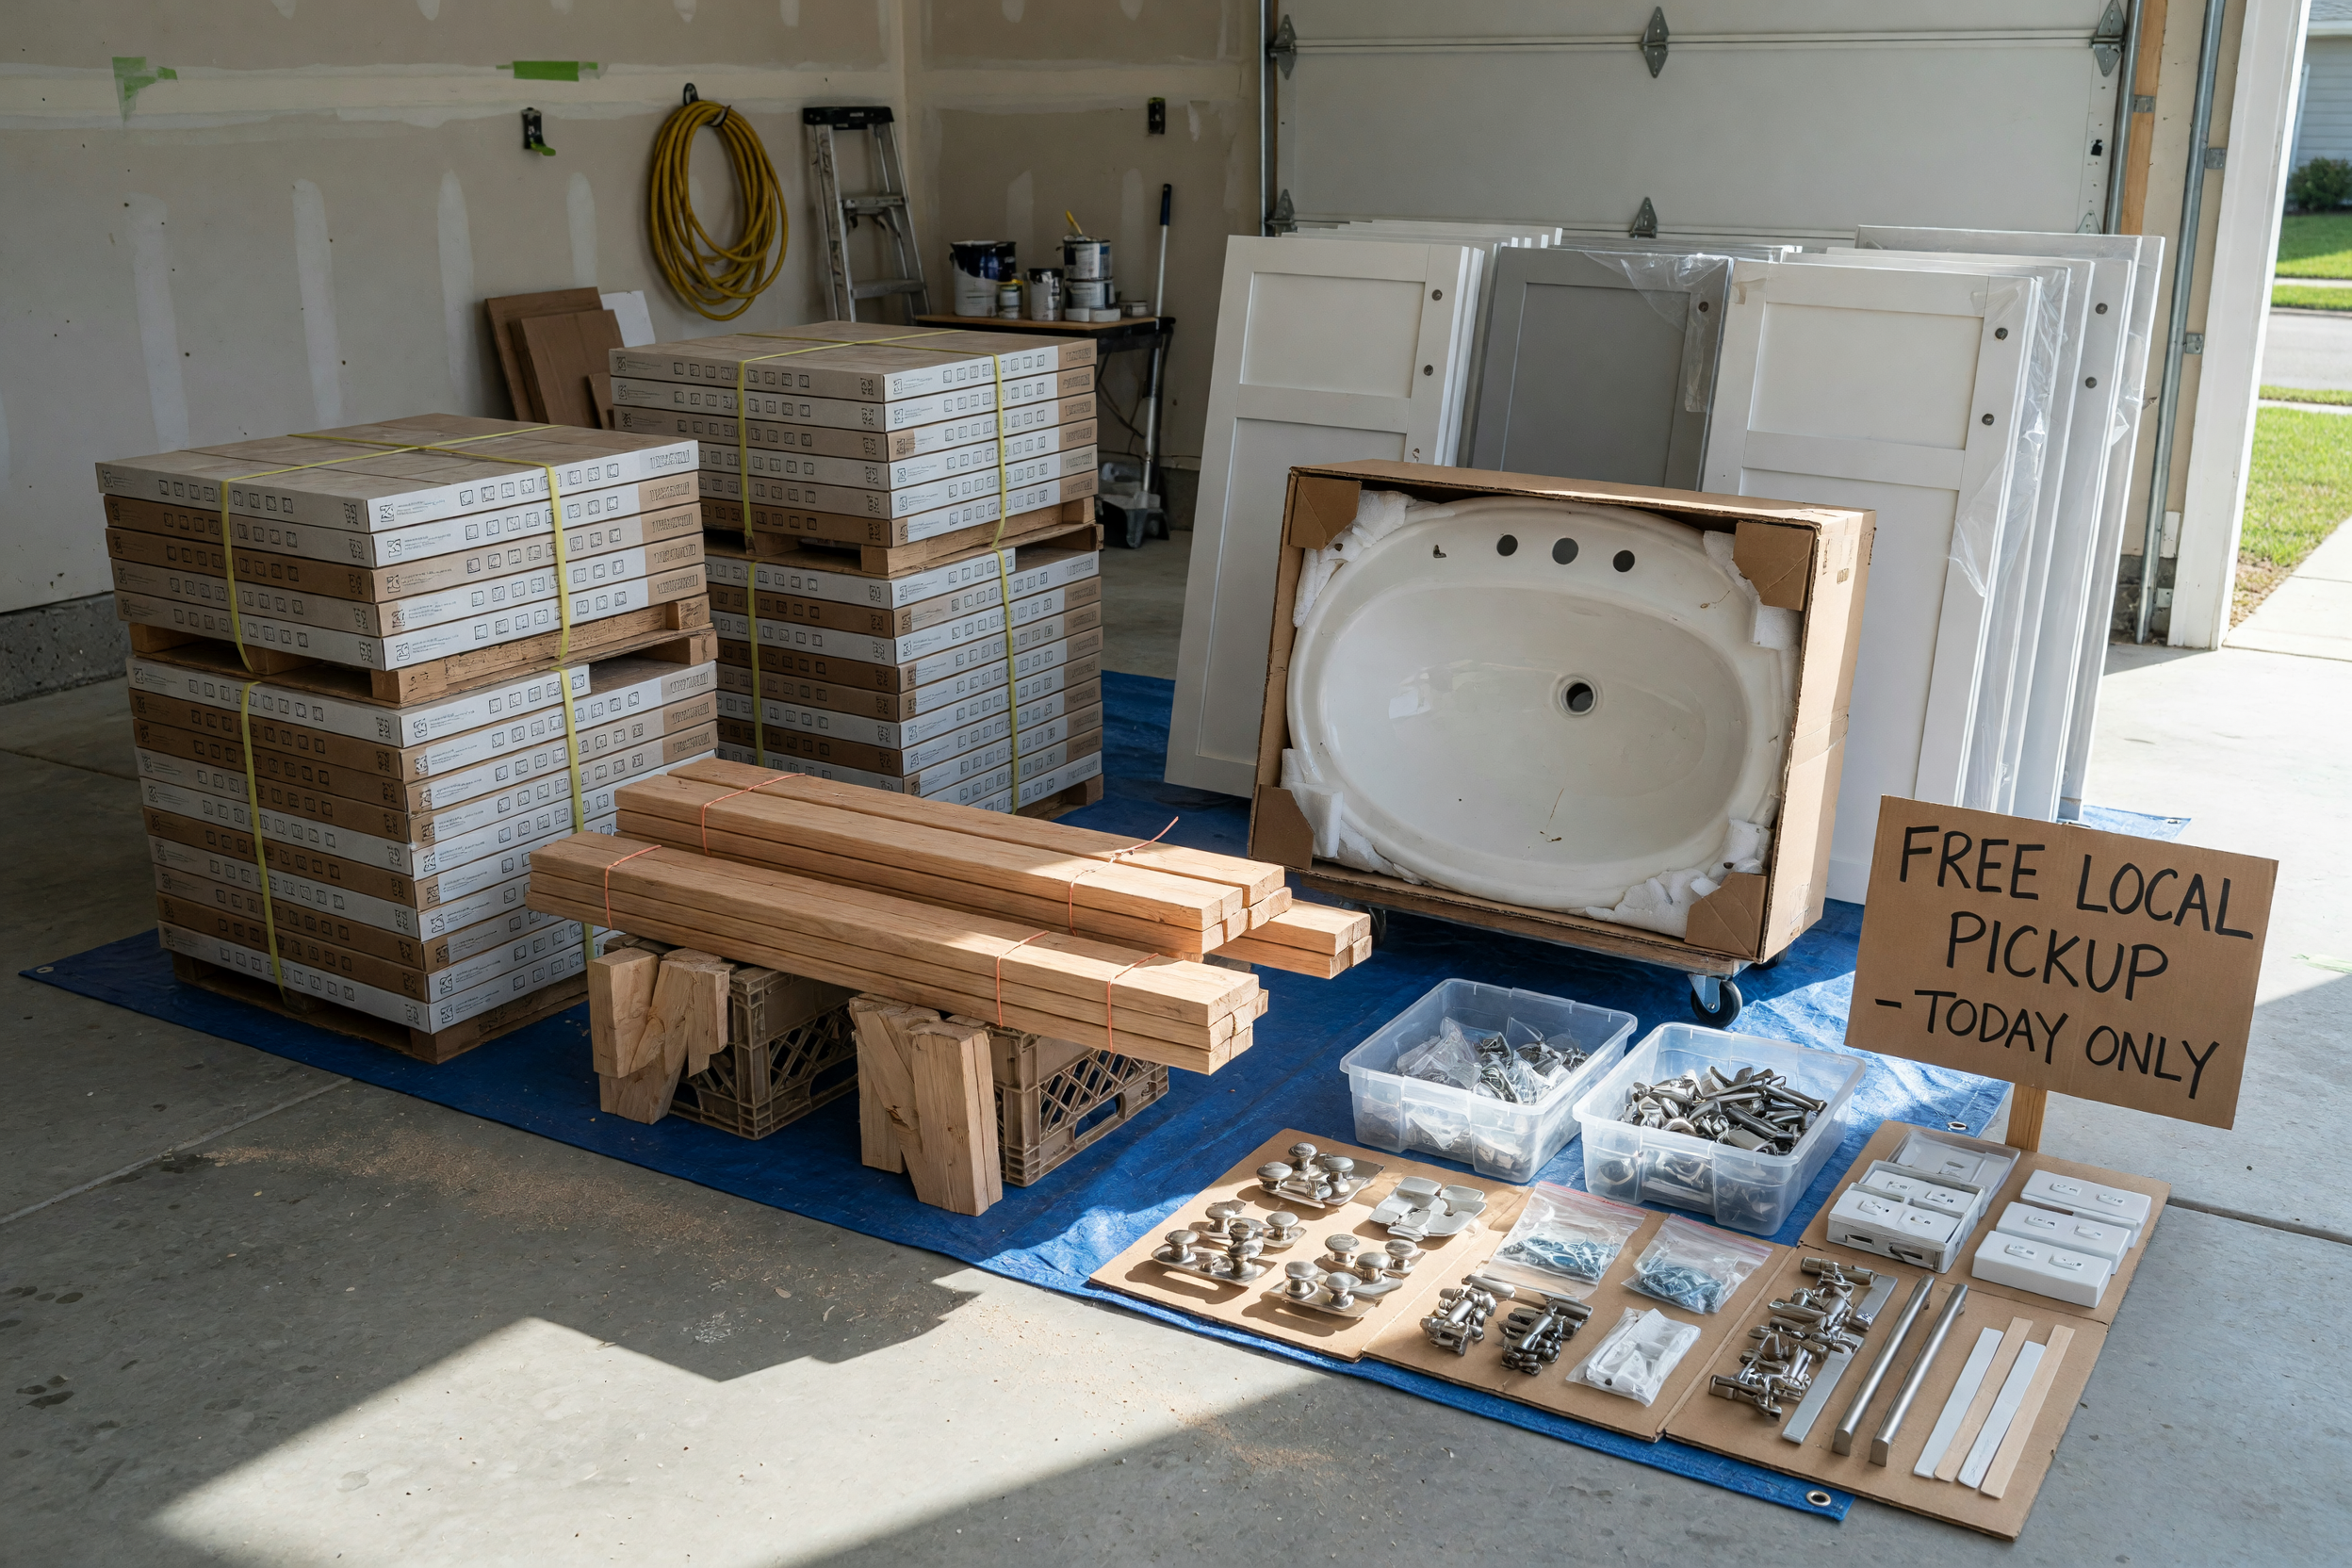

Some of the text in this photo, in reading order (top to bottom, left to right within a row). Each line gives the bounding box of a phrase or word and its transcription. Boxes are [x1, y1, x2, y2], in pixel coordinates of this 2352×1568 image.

[1899, 825, 2254, 940] FREE LOCAL
[1946, 910, 2169, 1002] PICKUP
[2084, 1024, 2221, 1101] ONLY
